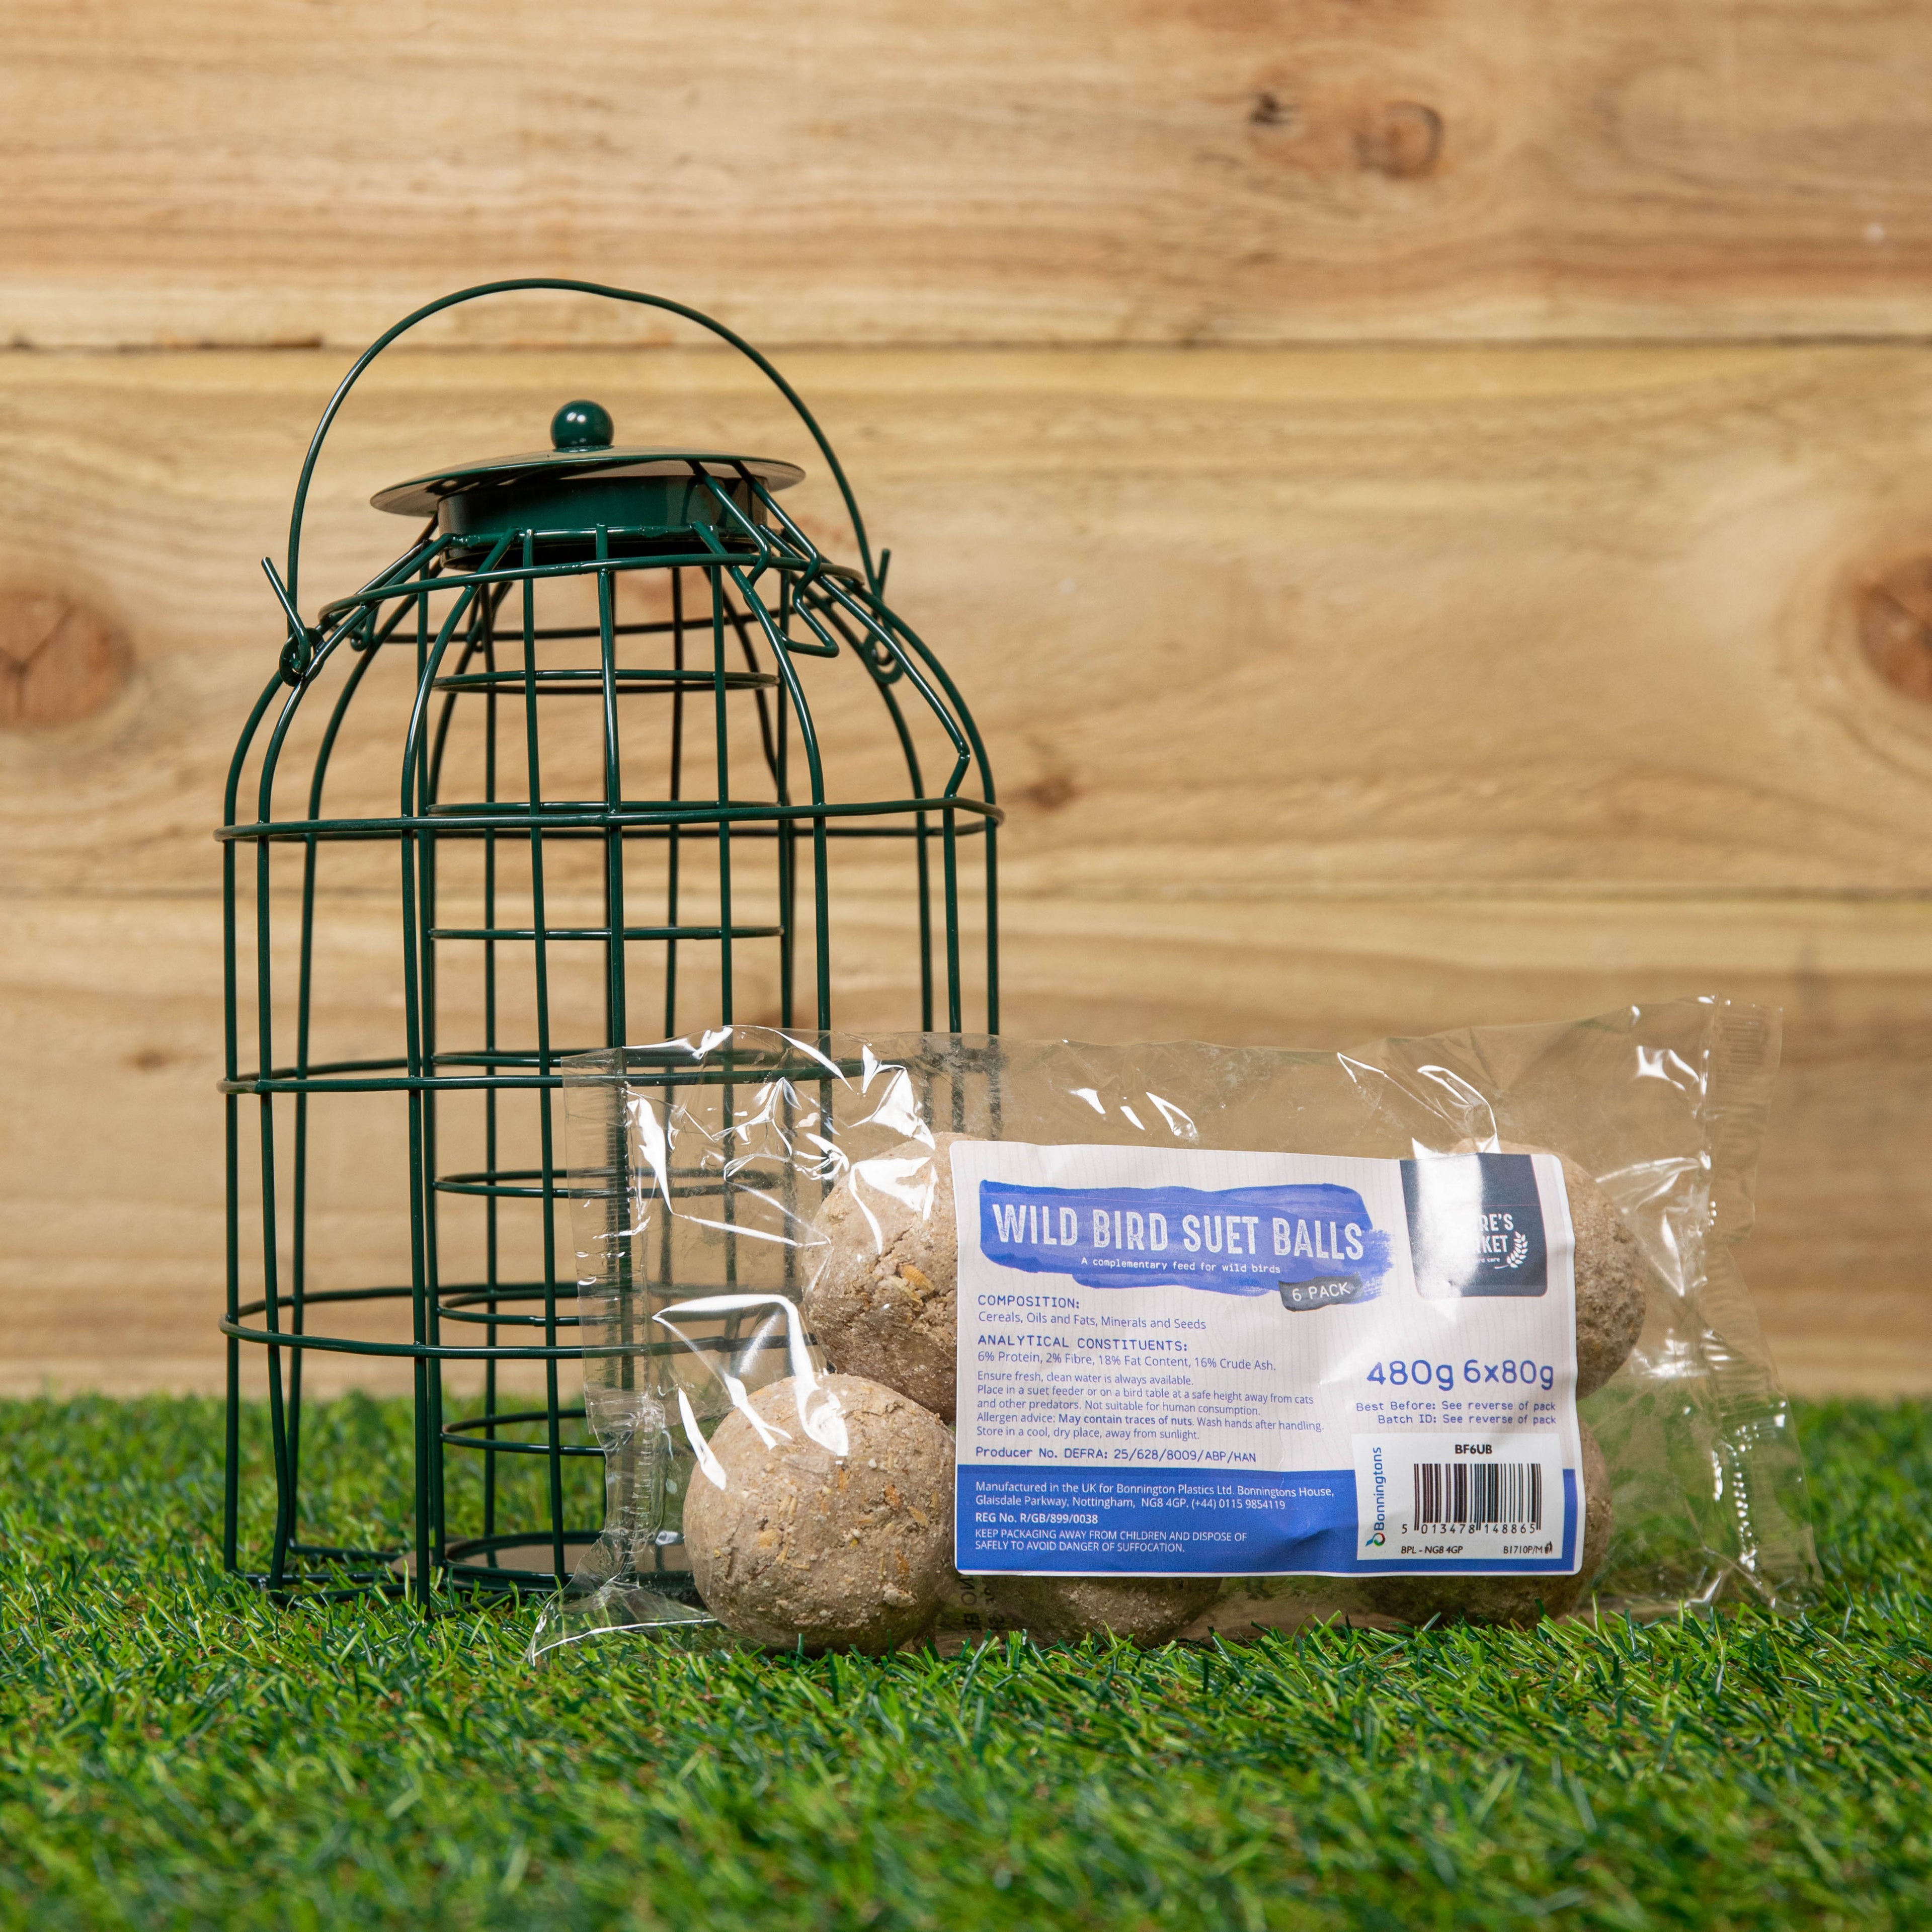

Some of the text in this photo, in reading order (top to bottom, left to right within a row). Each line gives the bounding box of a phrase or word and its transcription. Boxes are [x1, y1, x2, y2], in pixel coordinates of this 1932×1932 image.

[992, 1204, 1363, 1260] WILD BIRD SUET BALLS
[1081, 1257, 1280, 1273] A complementary feed for wild birds
[1292, 1282, 1350, 1302] 6 PACK
[978, 1295, 1080, 1309] COMPOSITION:
[978, 1311, 1206, 1330] Cereals, Oils and Fats, Minerals and Seeds
[978, 1334, 1188, 1351] ANALYTICAL CONSTITUENTS:
[978, 1351, 1276, 1371] 6% Protein, 2% Fibre, 18% Fat Content, 16% Crude Ash.
[978, 1371, 1194, 1387] Ensure fresh, clean water is always available.
[1366, 1359, 1554, 1392] 480g 6x80g
[978, 1384, 1003, 1395] Place
[1027, 1387, 1050, 1396] suet
[1052, 1386, 1084, 1396] feeder
[1123, 1388, 1143, 1398] bird
[1146, 1388, 1170, 1398] table
[1172, 1390, 1182, 1399] at
[1192, 1390, 1211, 1400] safe
[1213, 1390, 1242, 1403] height
[1245, 1394, 1268, 1405] away
[1270, 1393, 1292, 1403] from
[1295, 1396, 1314, 1404] cats
[977, 1398, 1260, 1417] and other predators. Not suitable for human consumption.
[1356, 1400, 1555, 1412] Best Before: See reverse of pack
[977, 1411, 1324, 1433] Allergen advice: May contain traces of nuts. Wash hands after handling.
[1378, 1414, 1556, 1426] Batch ID: See reverse of pack
[977, 1426, 1003, 1436] Store
[1018, 1428, 1024, 1436] a
[1026, 1426, 1050, 1438] cool,
[1053, 1427, 1071, 1439] dry
[1073, 1427, 1102, 1439] place,
[1105, 1430, 1131, 1440] away
[1133, 1428, 1157, 1438] from
[1159, 1429, 1199, 1442] sunlight.
[976, 1446, 1256, 1464] Producer No. DEFRA: 25/628/8009/ABP/HAN
[1455, 1444, 1492, 1455] BF6UB
[976, 1481, 1334, 1499] Manufactured in the UK for Bonnington Plastics Ltd. Bonningtons House,
[1373, 1447, 1386, 1531] Bonningtons
[976, 1494, 1285, 1510] Glaisdale Parkway, Nottingham, NG8 4GP. (+44) 0115 9854119
[976, 1512, 1098, 1524] REG No. R/GB/899/0038
[975, 1528, 1247, 1542] KEEP PACKAGING AWAY FROM CHILDREN AND DISPOSE OF
[1402, 1524, 1407, 1534] 5
[975, 1540, 1185, 1553] SAFELY TO AVOID DANGER OF SUFFOCATION.
